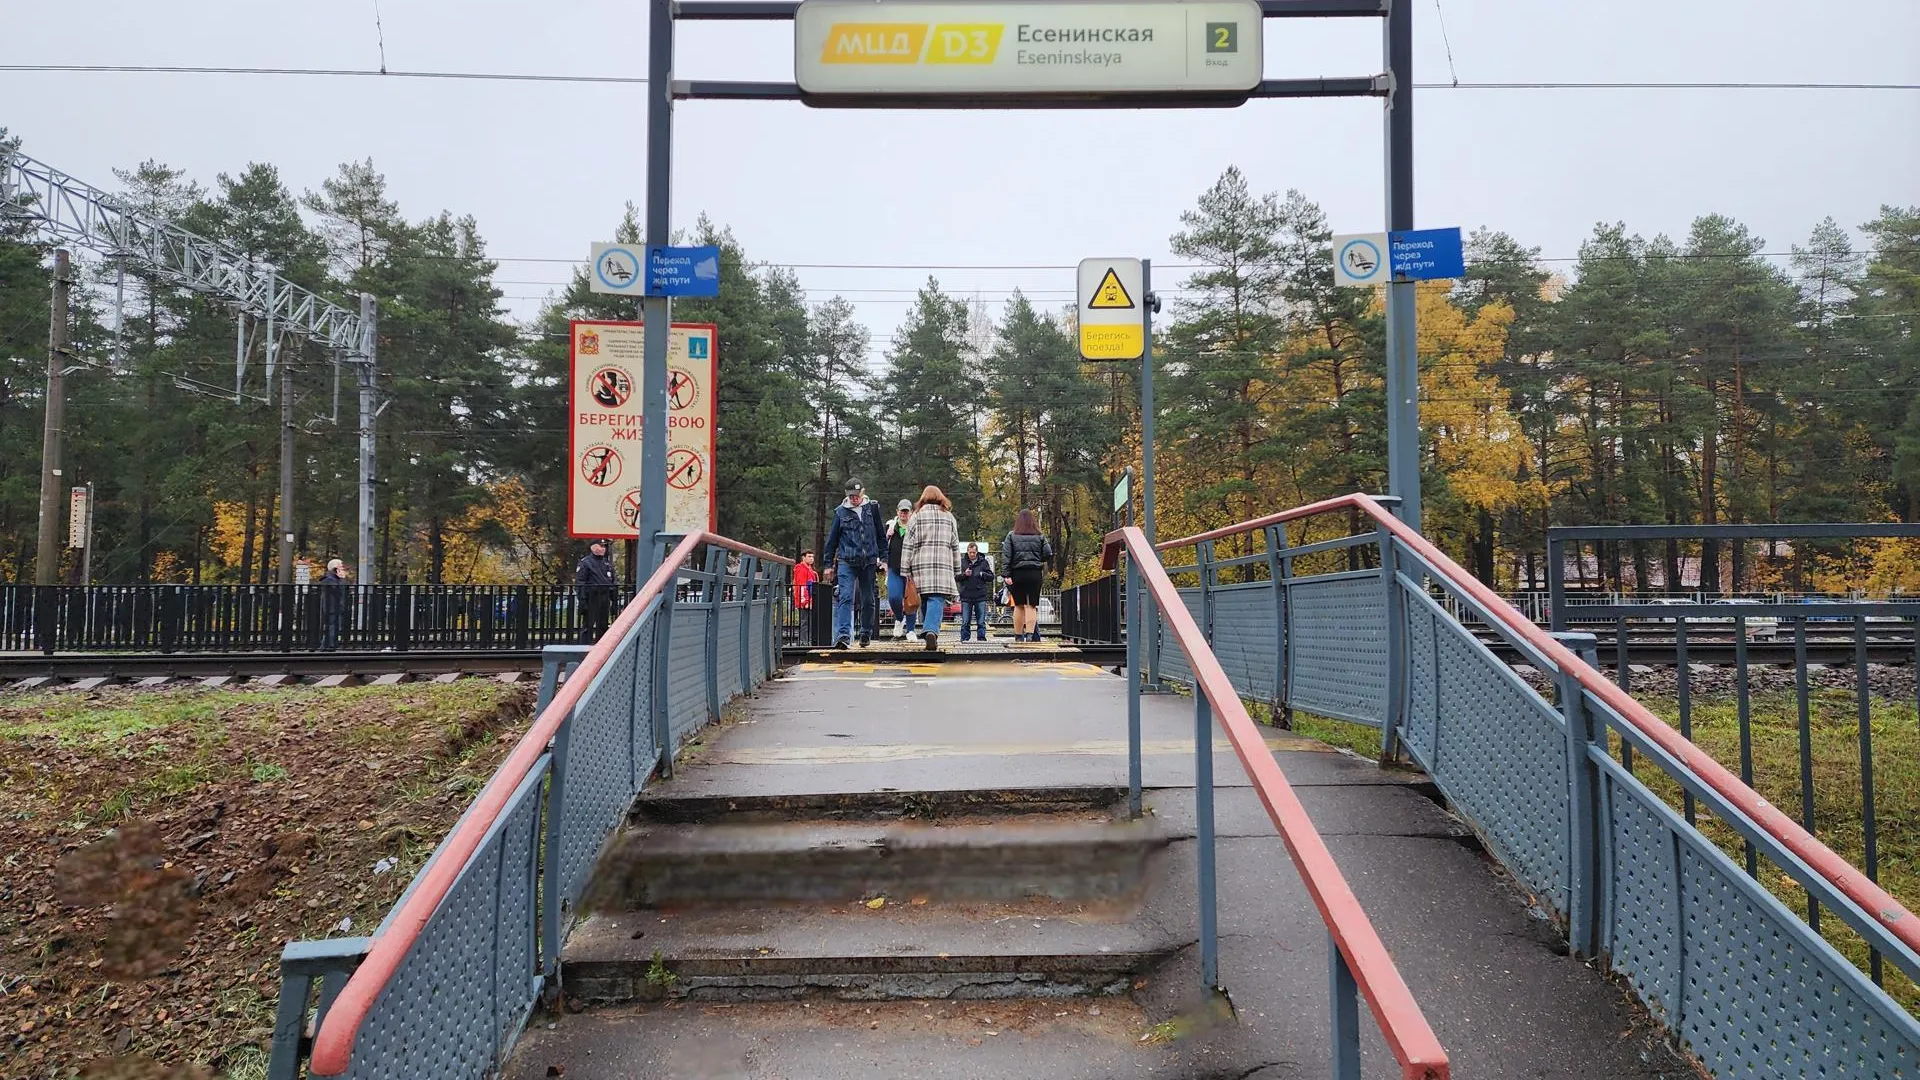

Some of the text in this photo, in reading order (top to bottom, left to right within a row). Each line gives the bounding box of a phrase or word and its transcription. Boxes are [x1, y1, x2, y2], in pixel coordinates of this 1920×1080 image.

[1018, 24, 1154, 42] Есенинская
[1215, 27, 1230, 48] 2
[836, 32, 911, 55] МЦД
[942, 30, 990, 58] D3
[1017, 48, 1123, 67] Eseninskaya
[1206, 58, 1228, 67] Вход
[1393, 241, 1434, 250] Переход
[653, 256, 691, 266] Переход
[1394, 252, 1422, 261] через
[1395, 261, 1435, 271] ж/д пути
[653, 267, 679, 276] через
[653, 277, 691, 287] ж/д пути
[1086, 341, 1124, 352] поезда!
[579, 413, 705, 429] БЕРЕГИТ ВОЮ
